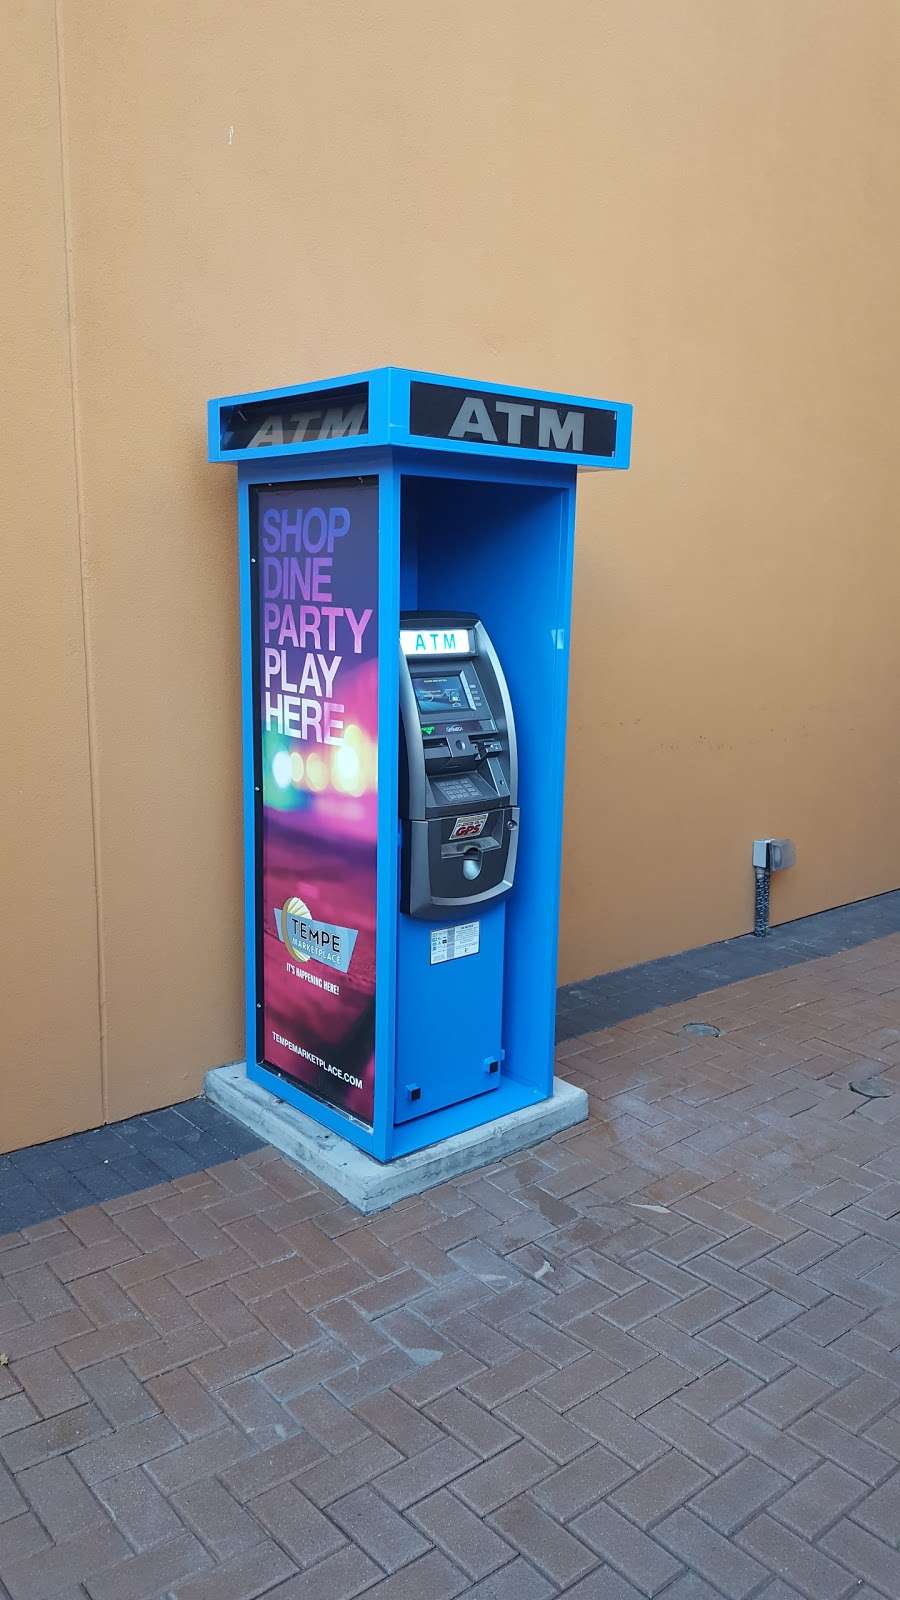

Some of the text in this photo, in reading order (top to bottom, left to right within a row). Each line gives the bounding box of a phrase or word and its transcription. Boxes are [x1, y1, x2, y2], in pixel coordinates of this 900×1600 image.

[246, 402, 367, 448] ATM
[448, 397, 585, 451] ATM
[262, 507, 350, 553] SHOP
[263, 556, 333, 602] DINE
[264, 602, 373, 654] PARTY
[415, 633, 456, 651] ATM
[264, 647, 342, 698] PLAY
[265, 691, 345, 747] HERE
[291, 918, 340, 953] TEMPE
[292, 937, 341, 964] MARKETPLACE
[286, 962, 340, 996] IT'S HAPPENING HERE!
[271, 1031, 363, 1089] TEMPEMARKETPLACE.COM
